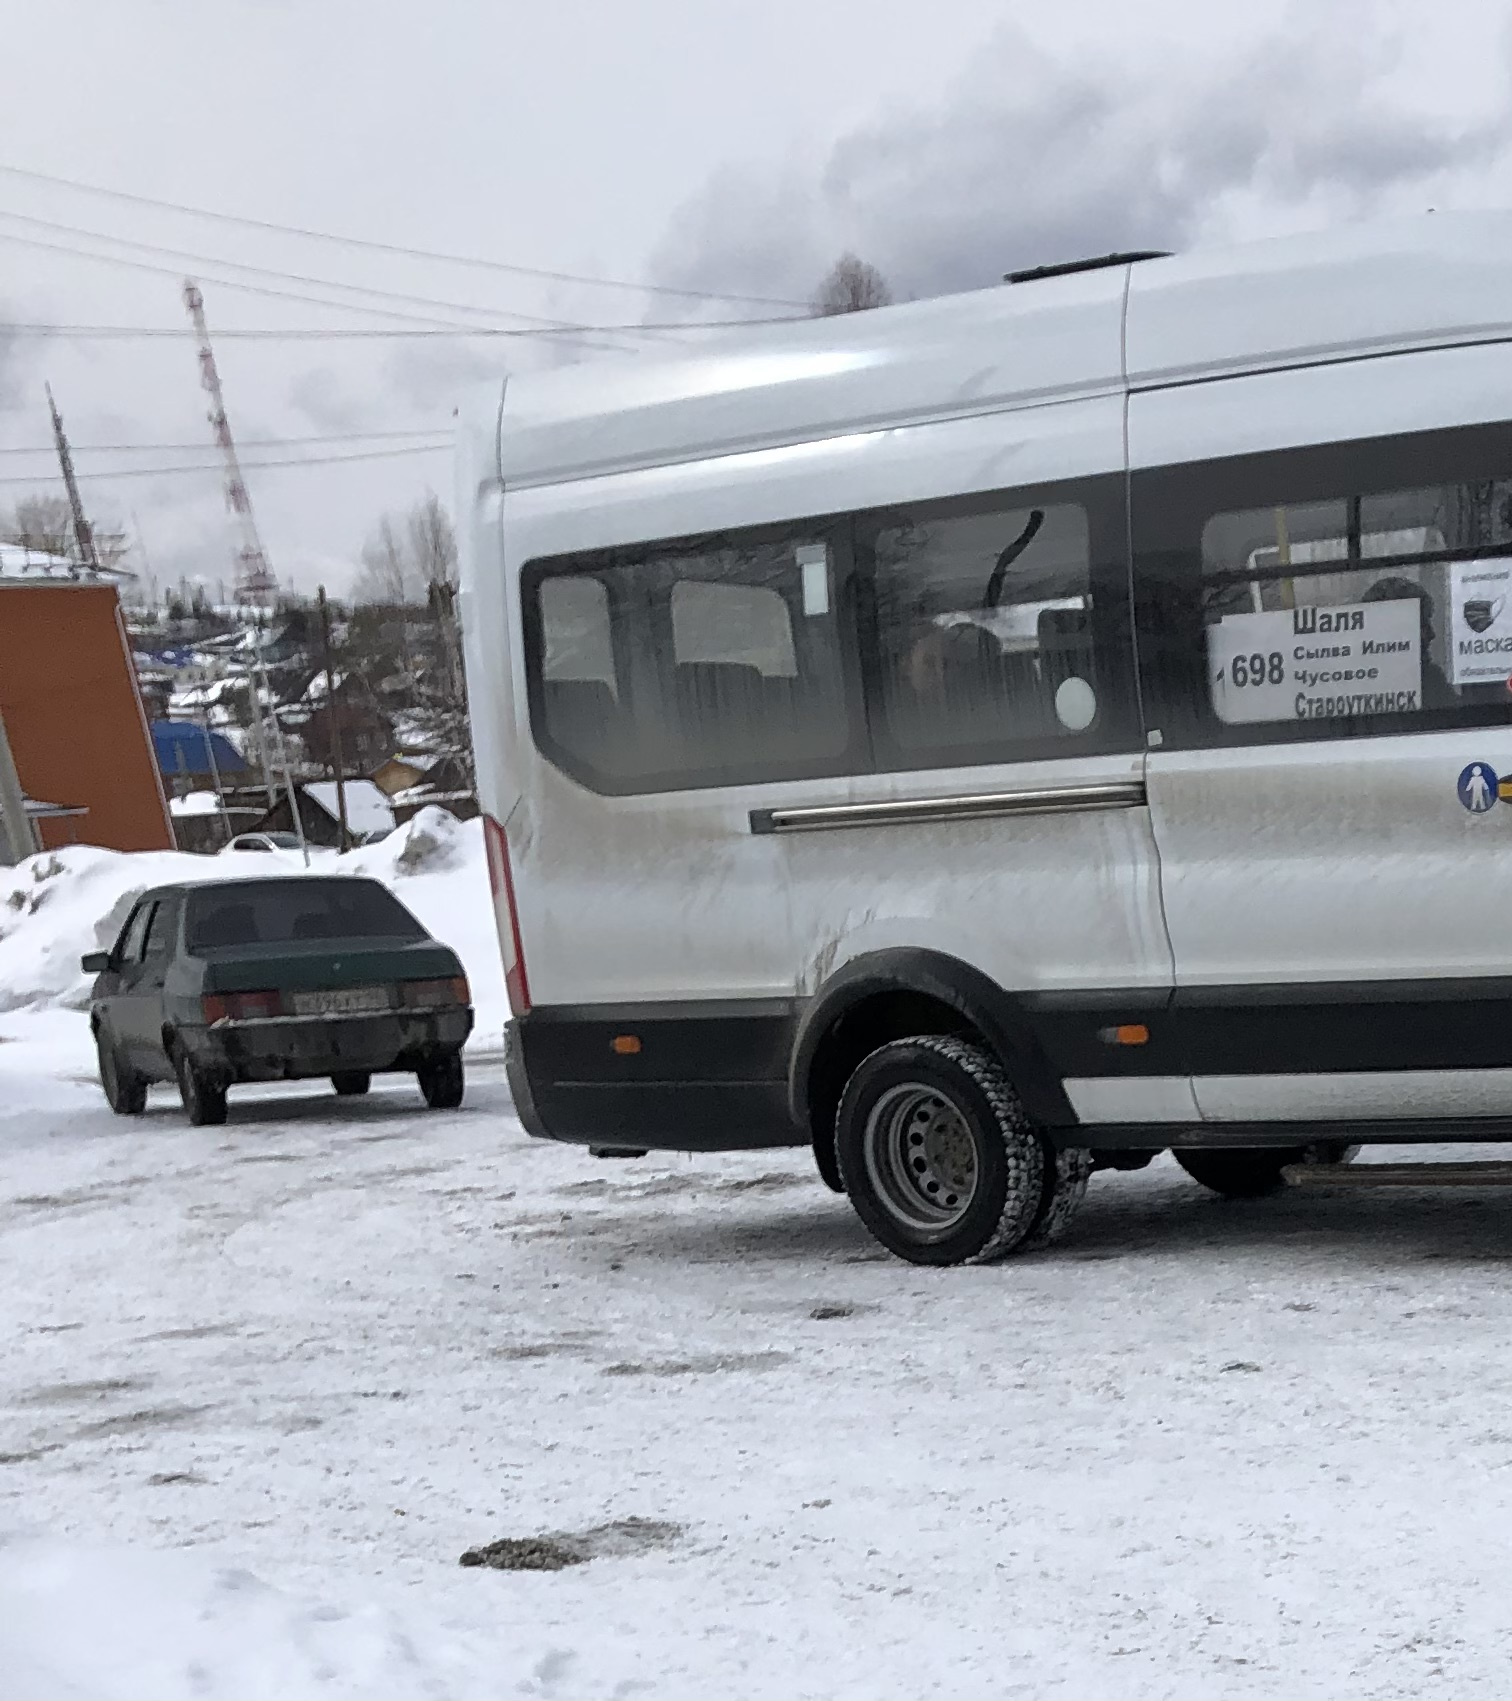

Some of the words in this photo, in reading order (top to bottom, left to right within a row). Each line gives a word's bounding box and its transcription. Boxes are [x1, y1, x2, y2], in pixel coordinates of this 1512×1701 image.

[1294, 607, 1364, 634] Шаля
[1294, 645, 1351, 660] Сылва
[1362, 640, 1411, 655] Илим
[1232, 652, 1284, 687] 698
[1294, 667, 1379, 687] Чусовое
